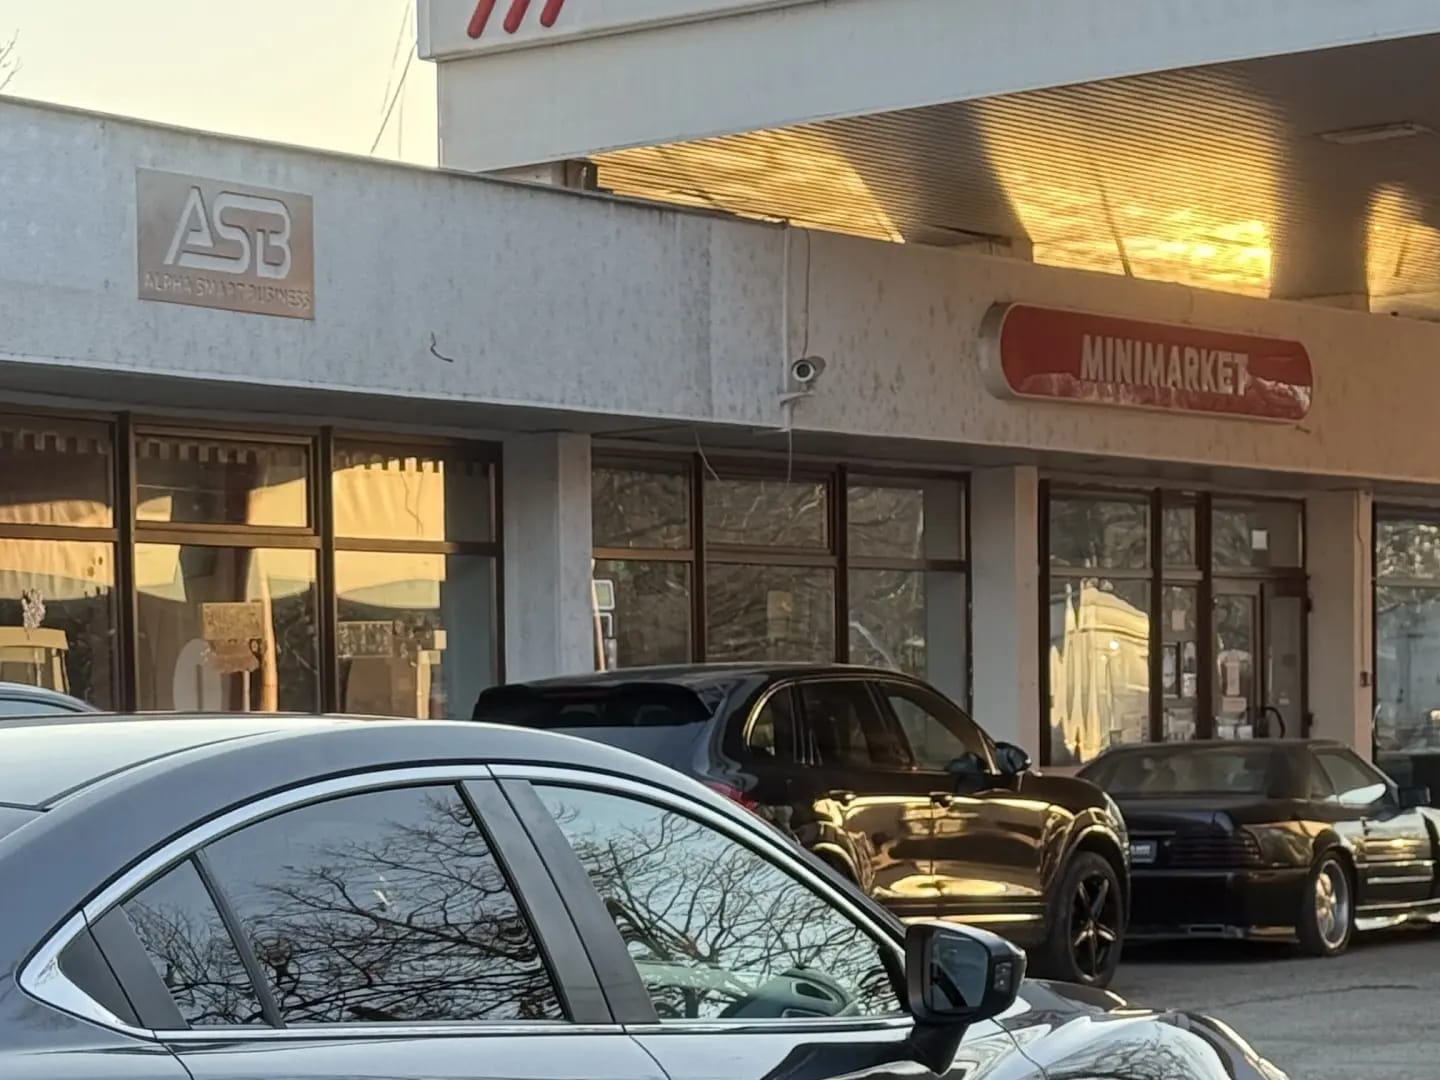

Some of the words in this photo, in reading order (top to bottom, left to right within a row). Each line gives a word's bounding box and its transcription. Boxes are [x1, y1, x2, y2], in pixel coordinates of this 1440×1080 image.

[163, 184, 293, 280] ASB
[143, 270, 193, 296] ALPHA
[1079, 333, 1250, 397] MINIMARKET
